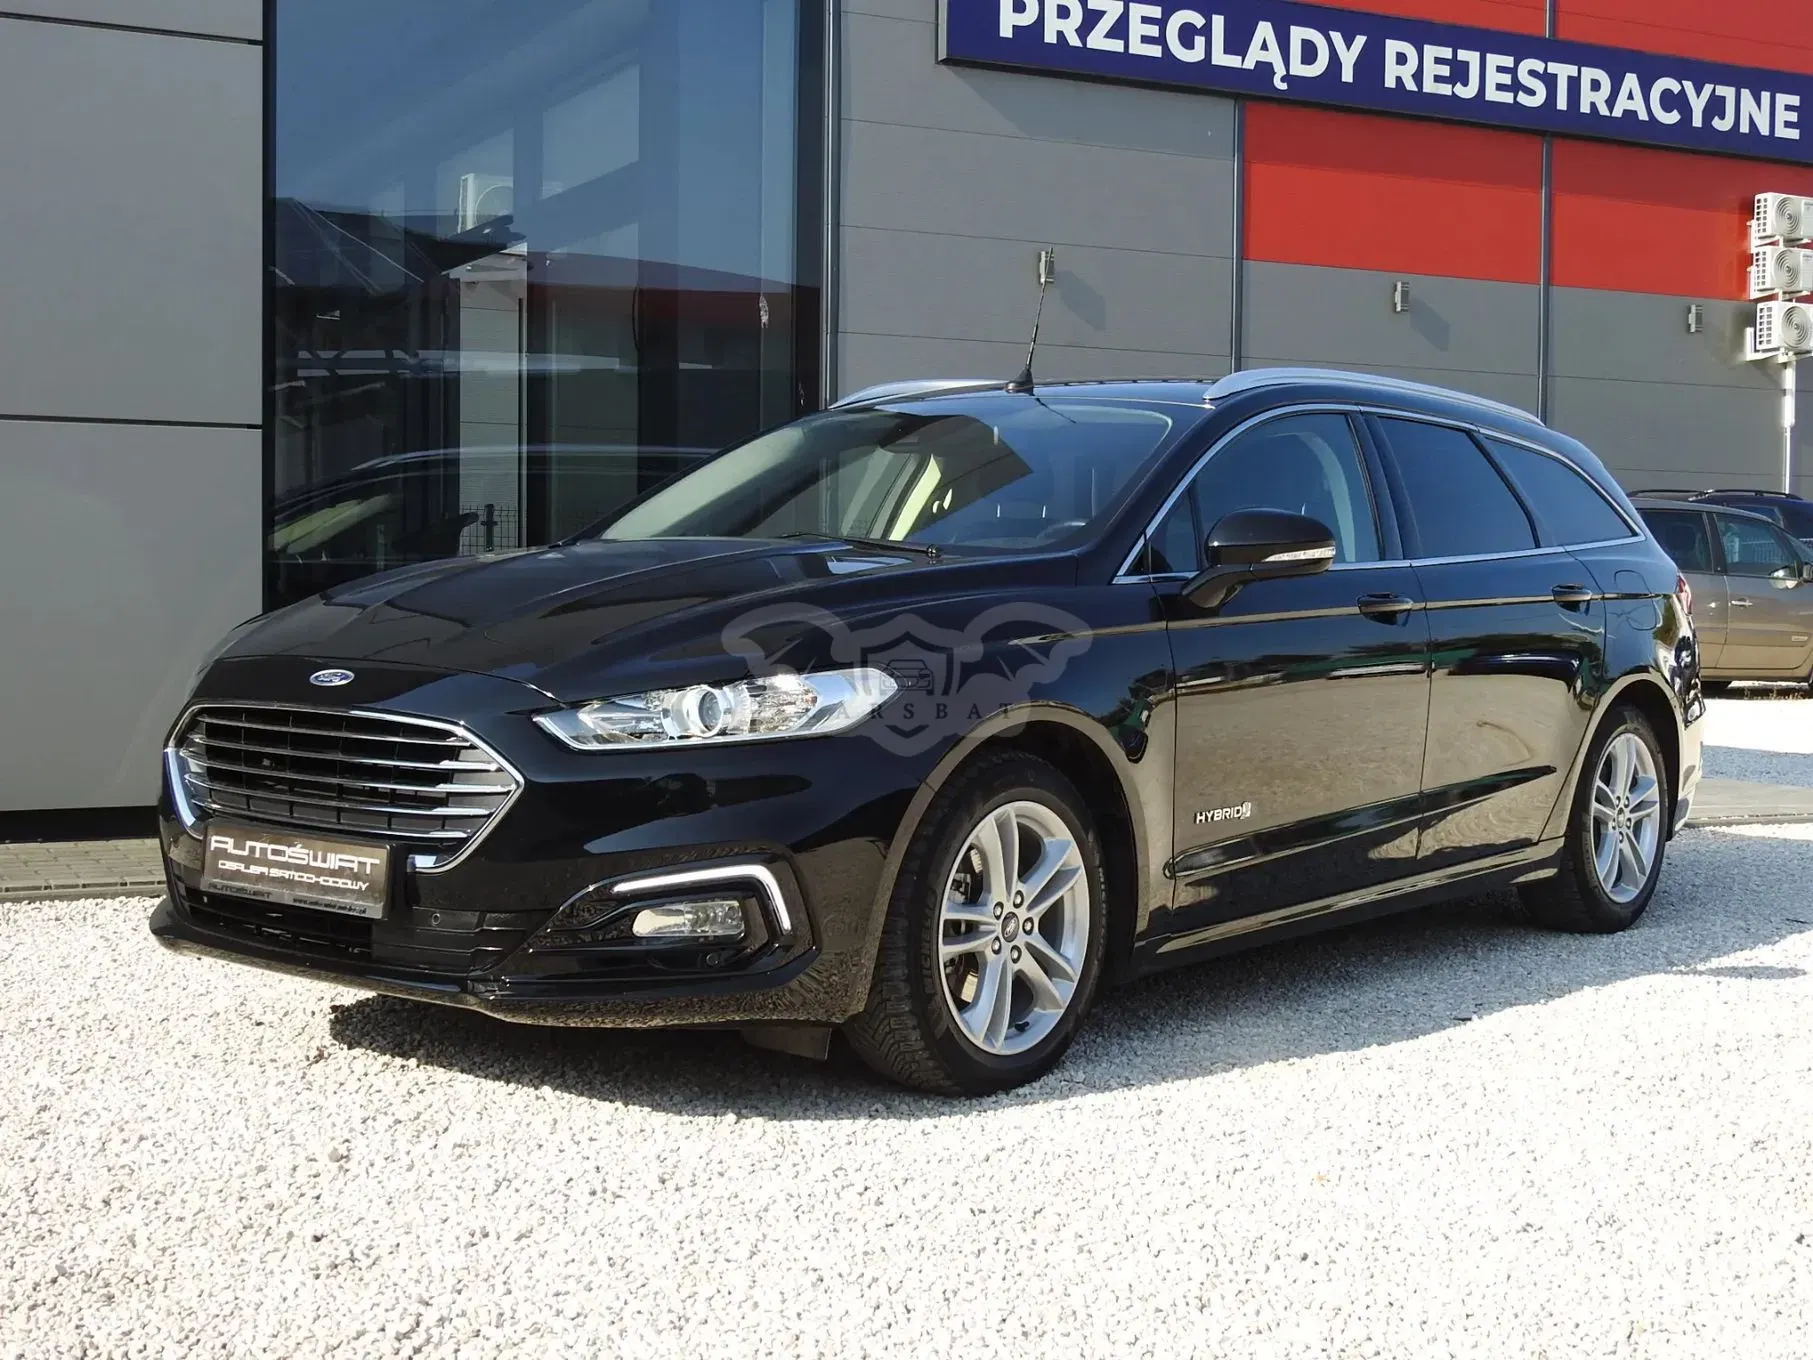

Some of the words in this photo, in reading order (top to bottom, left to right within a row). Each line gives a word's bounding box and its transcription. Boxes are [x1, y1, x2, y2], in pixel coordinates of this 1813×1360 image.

[998, 0, 1367, 92] PRZEGLĄDY
[1383, 38, 1801, 141] REJESTRACYJNE
[1196, 805, 1242, 825] HYBRID
[210, 835, 380, 874] AUTOŚWIAT
[218, 859, 269, 876] DEALER
